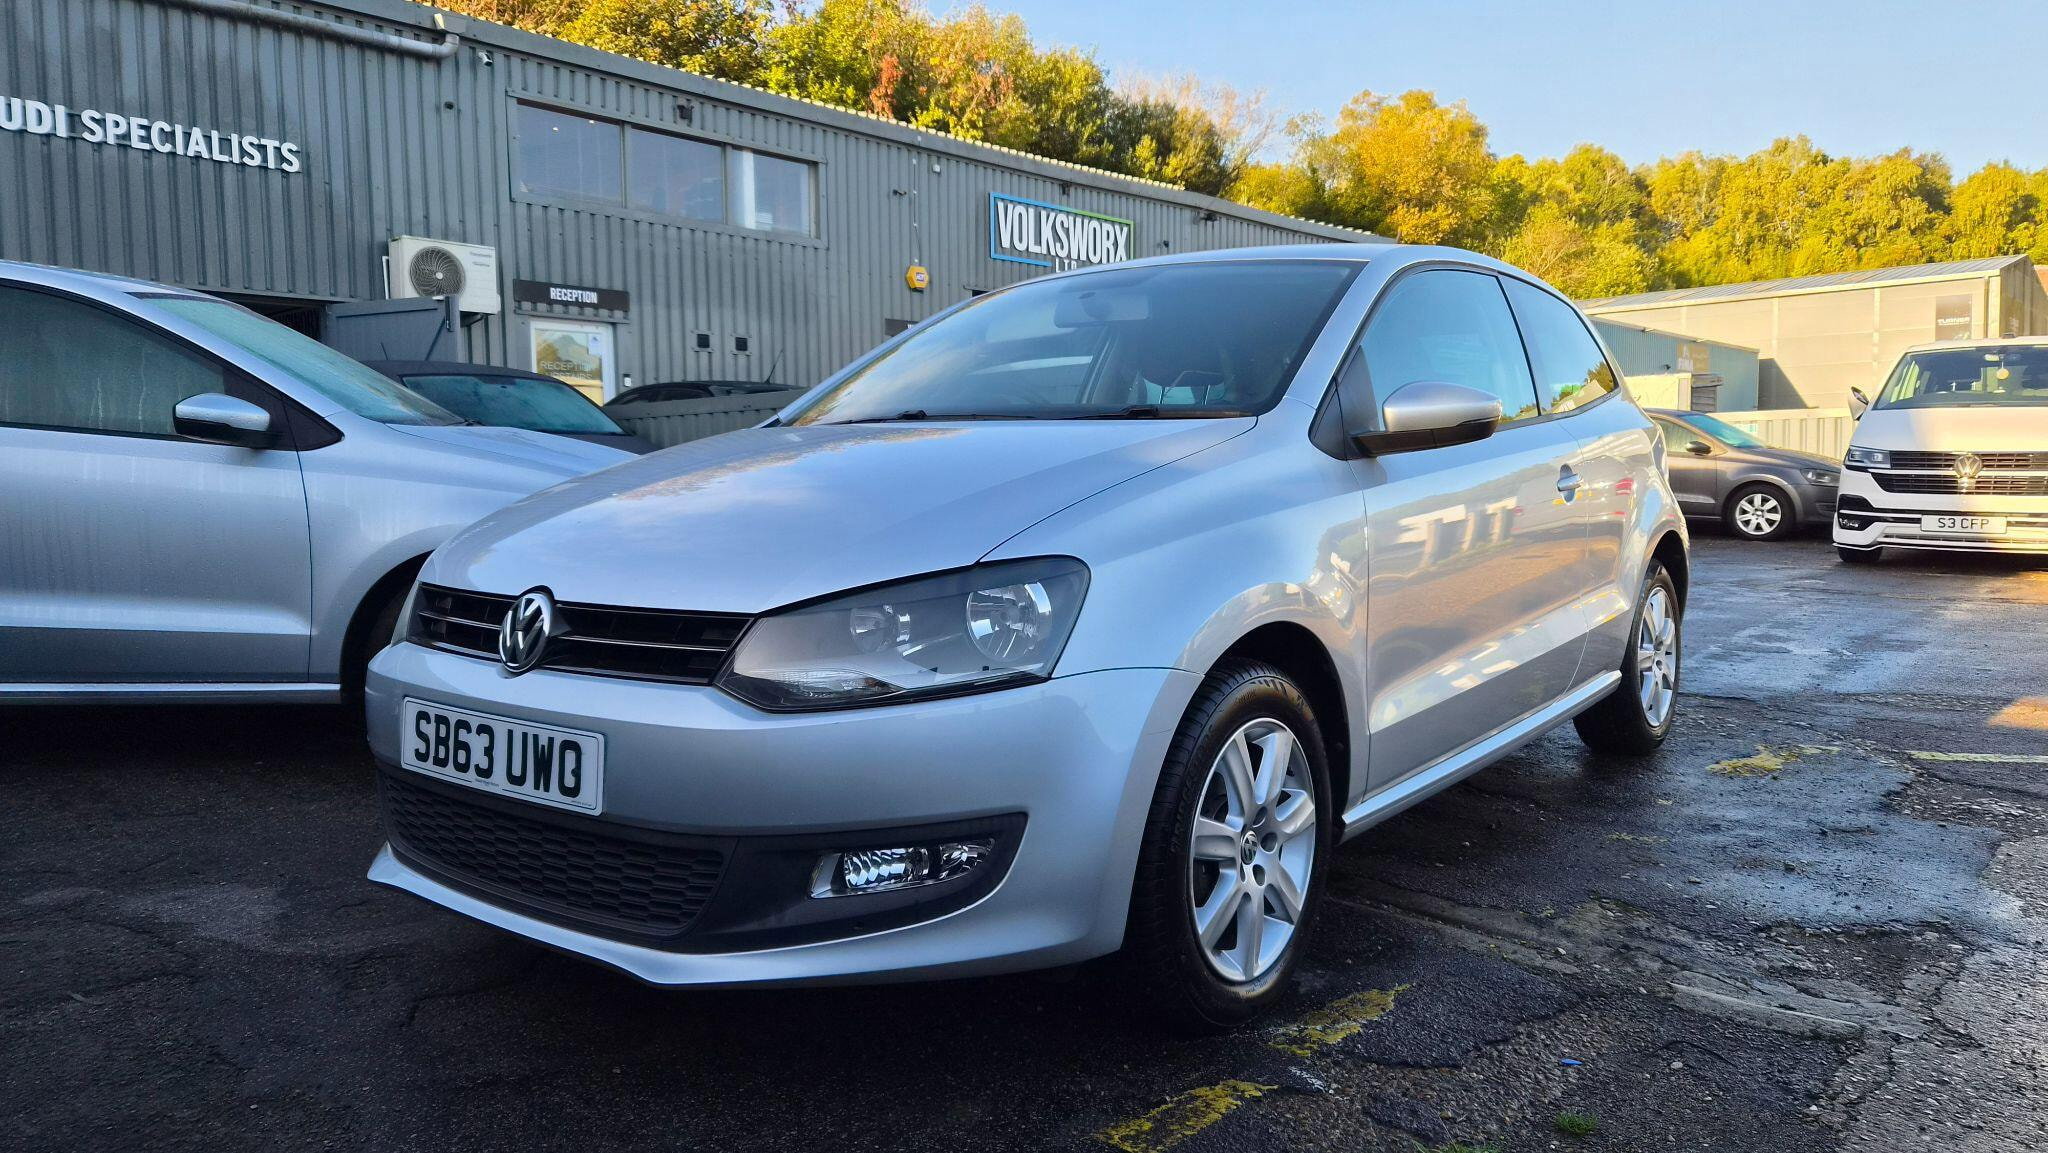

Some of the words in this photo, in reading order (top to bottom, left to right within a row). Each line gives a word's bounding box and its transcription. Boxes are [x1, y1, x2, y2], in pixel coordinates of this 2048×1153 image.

[81, 109, 300, 173] SPECIALISTS
[997, 201, 1129, 264] VOLKSWORX
[549, 287, 598, 304] RECEPTION
[1938, 517, 1956, 529] S3
[1960, 518, 1989, 529] CFP
[414, 710, 495, 779] SB63
[506, 728, 582, 798] UWO
